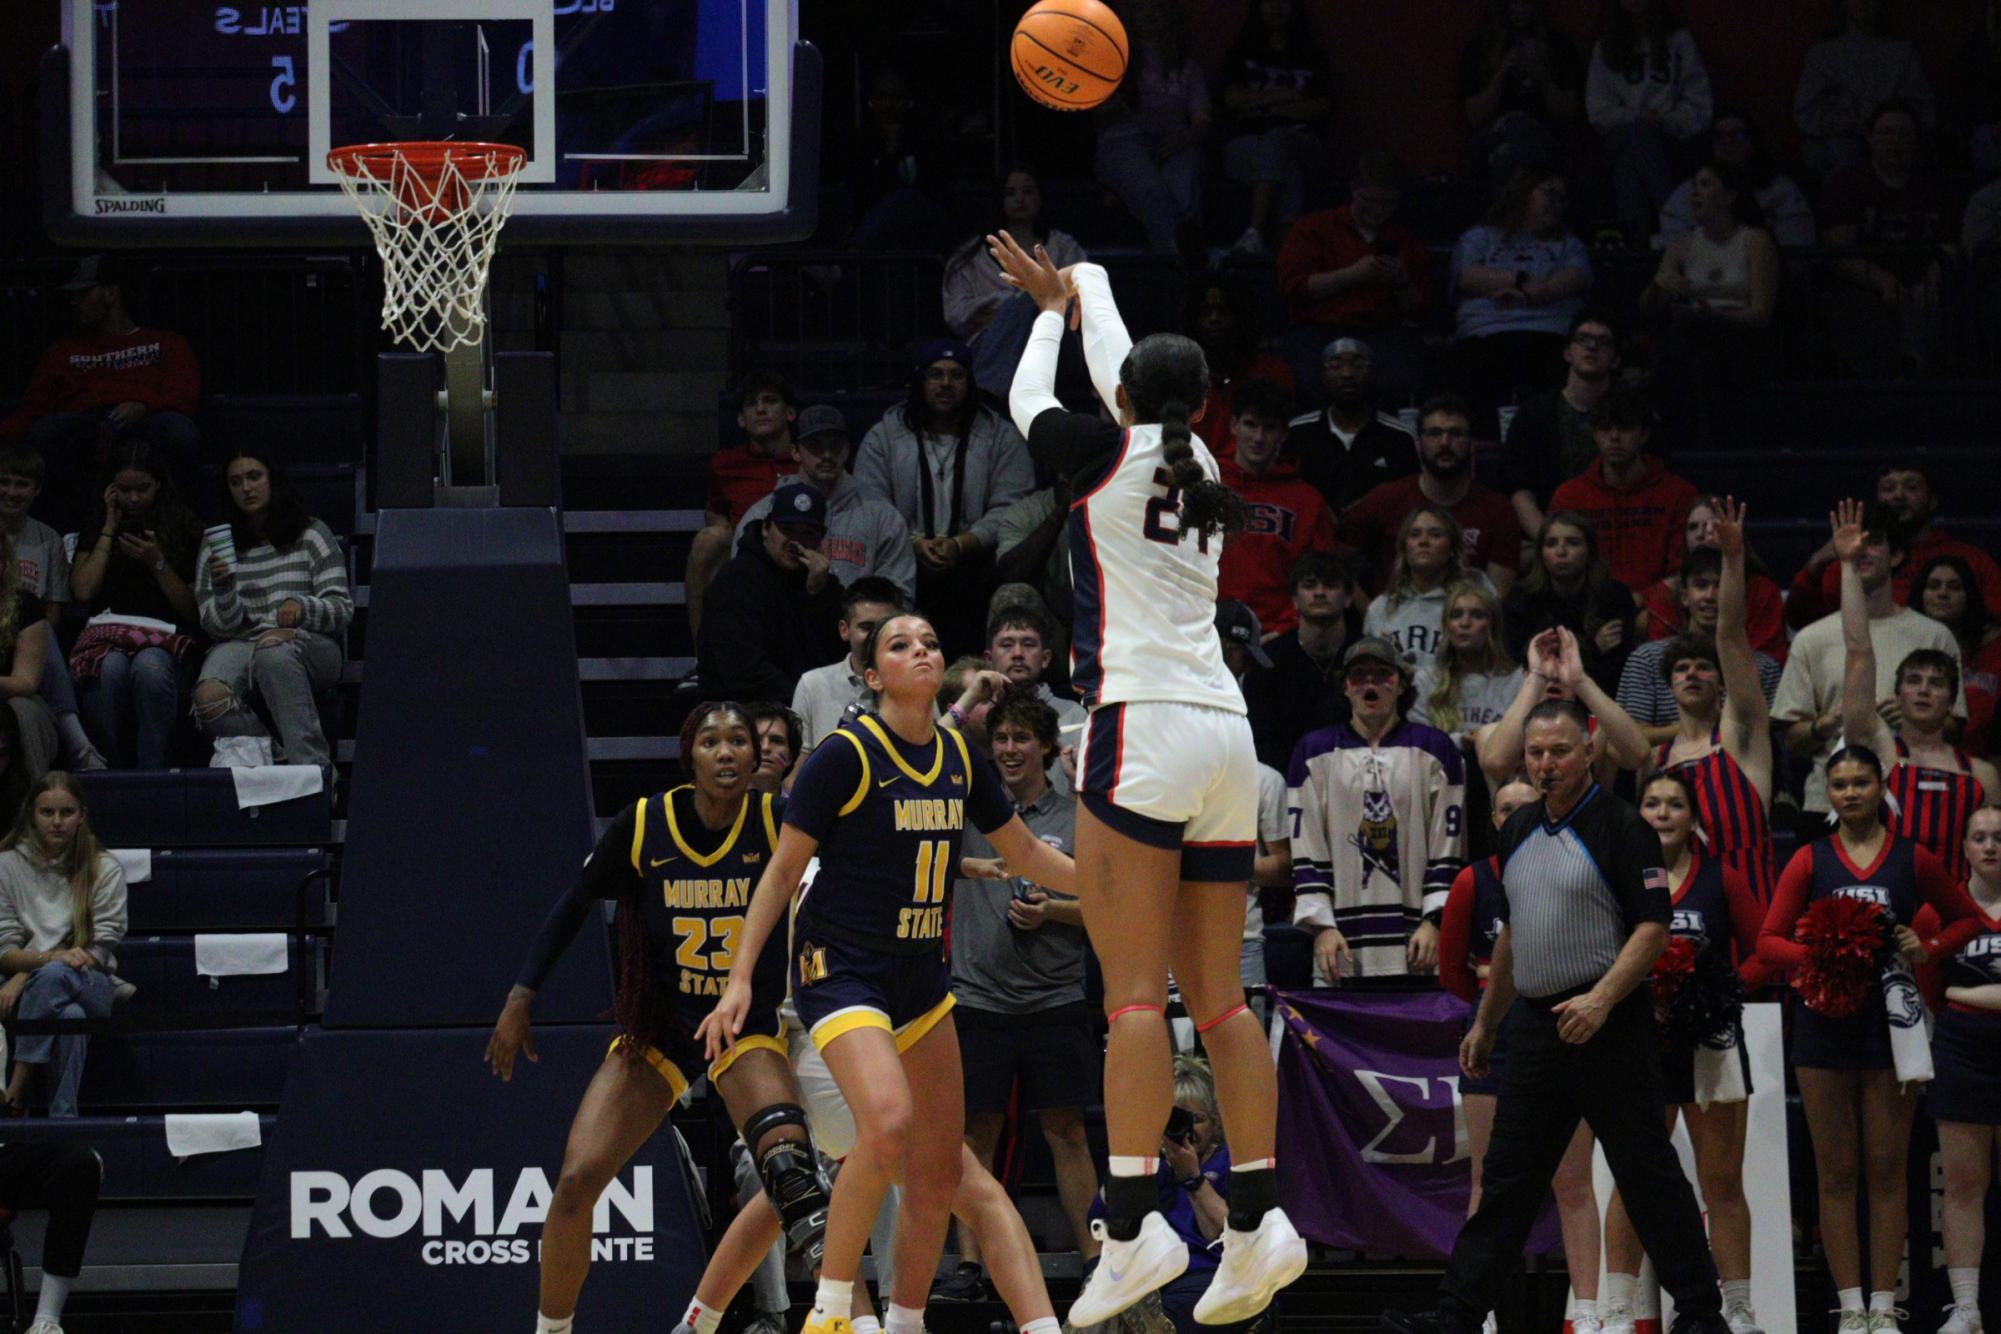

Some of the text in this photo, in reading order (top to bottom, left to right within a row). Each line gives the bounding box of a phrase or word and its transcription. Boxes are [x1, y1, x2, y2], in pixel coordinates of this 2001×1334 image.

[95, 198, 166, 214] SPALDING
[1143, 467, 1208, 555] 2
[1246, 502, 1296, 543] SI
[893, 798, 964, 831] MURRAY
[1446, 804, 1461, 837] 9
[912, 840, 951, 903] 11
[663, 877, 751, 909] MURRAY
[1669, 910, 1704, 932] SI
[672, 914, 745, 971] 23
[679, 967, 729, 996] STAT
[290, 1165, 654, 1239] ROMAN
[421, 1239, 530, 1266] CROSS
